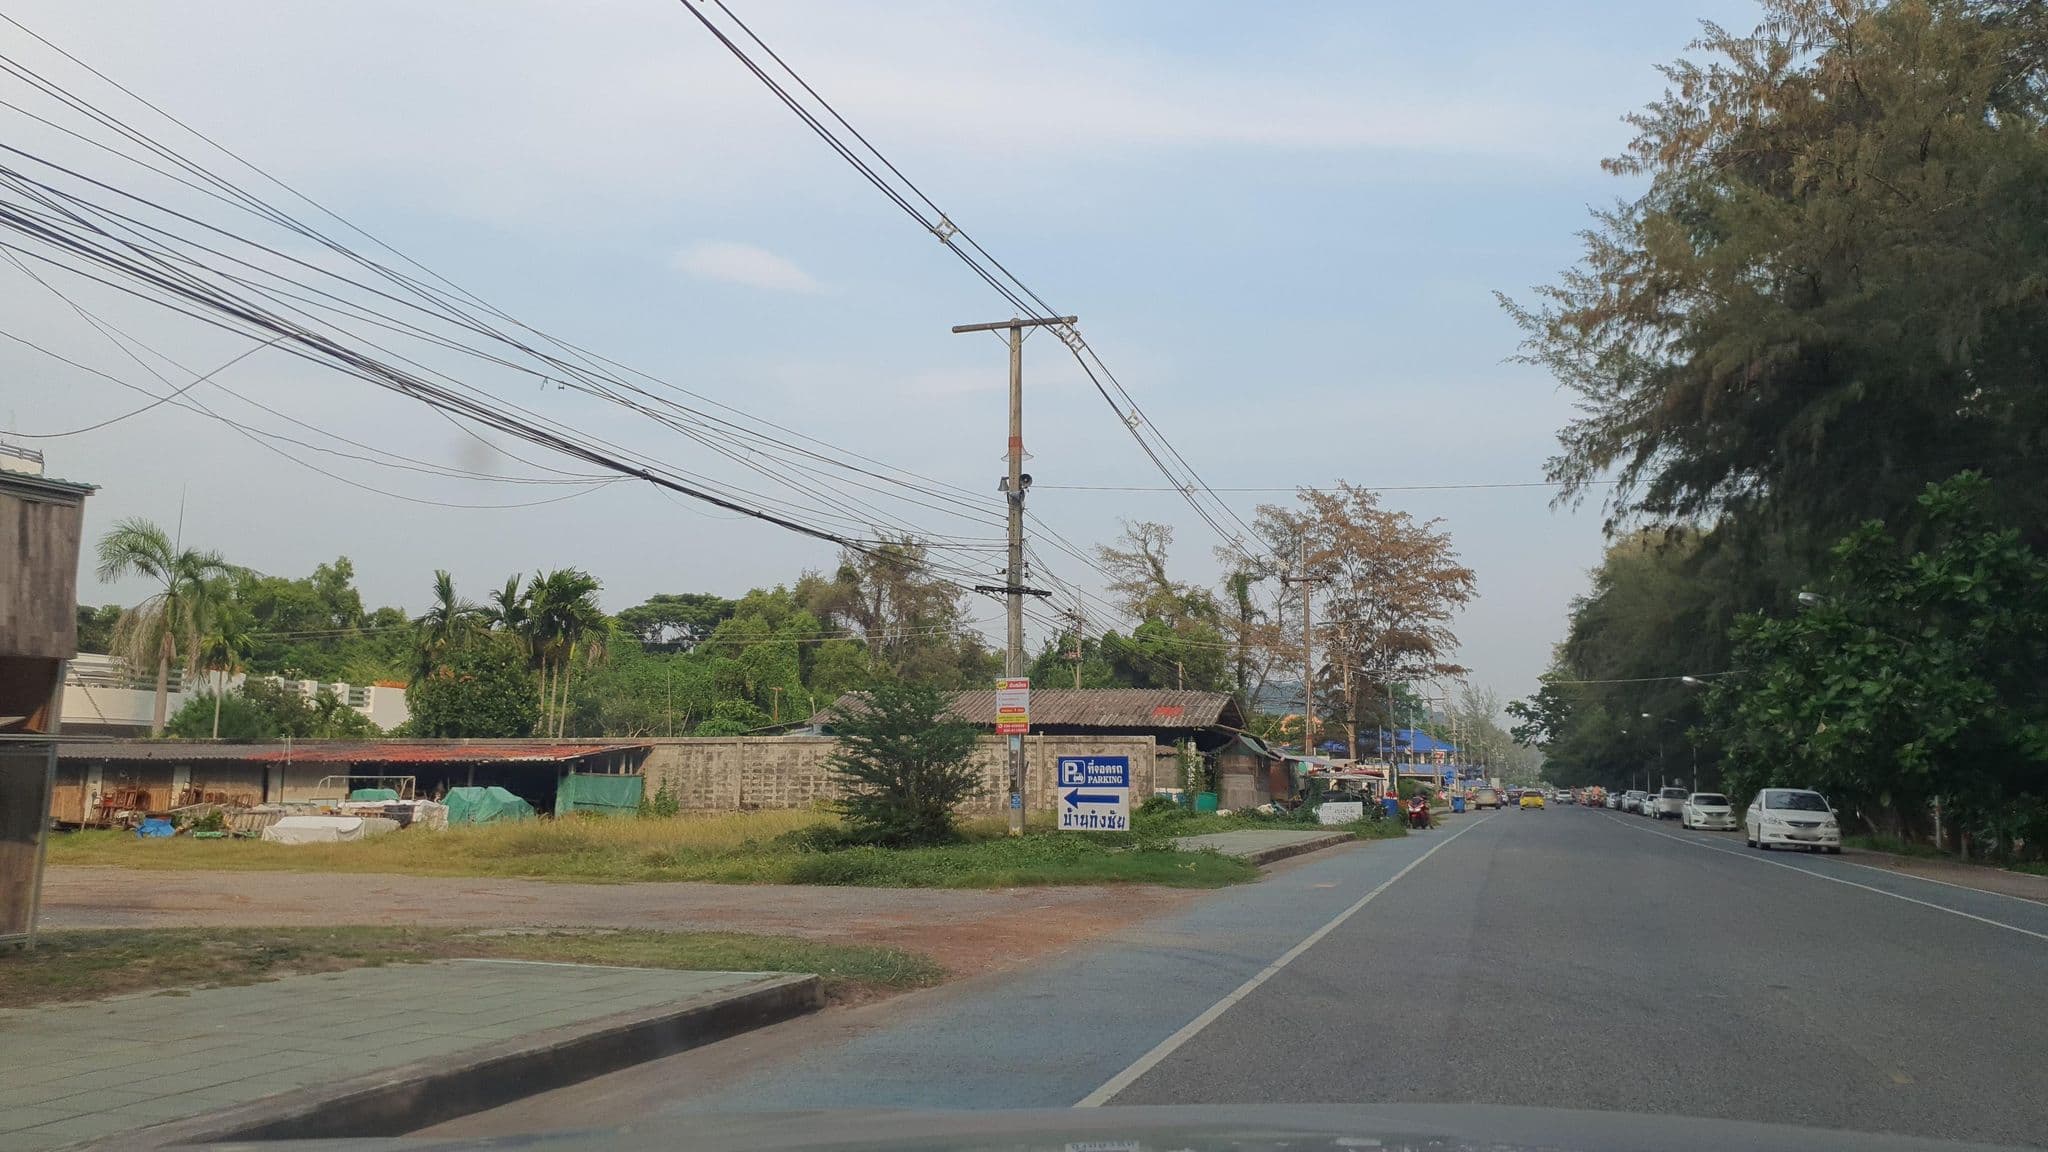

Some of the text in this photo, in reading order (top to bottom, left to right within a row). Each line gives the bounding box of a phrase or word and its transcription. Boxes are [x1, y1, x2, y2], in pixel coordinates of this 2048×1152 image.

[1087, 760, 1123, 775] ที่จอดรถ
[1087, 775, 1123, 784] PARKING
